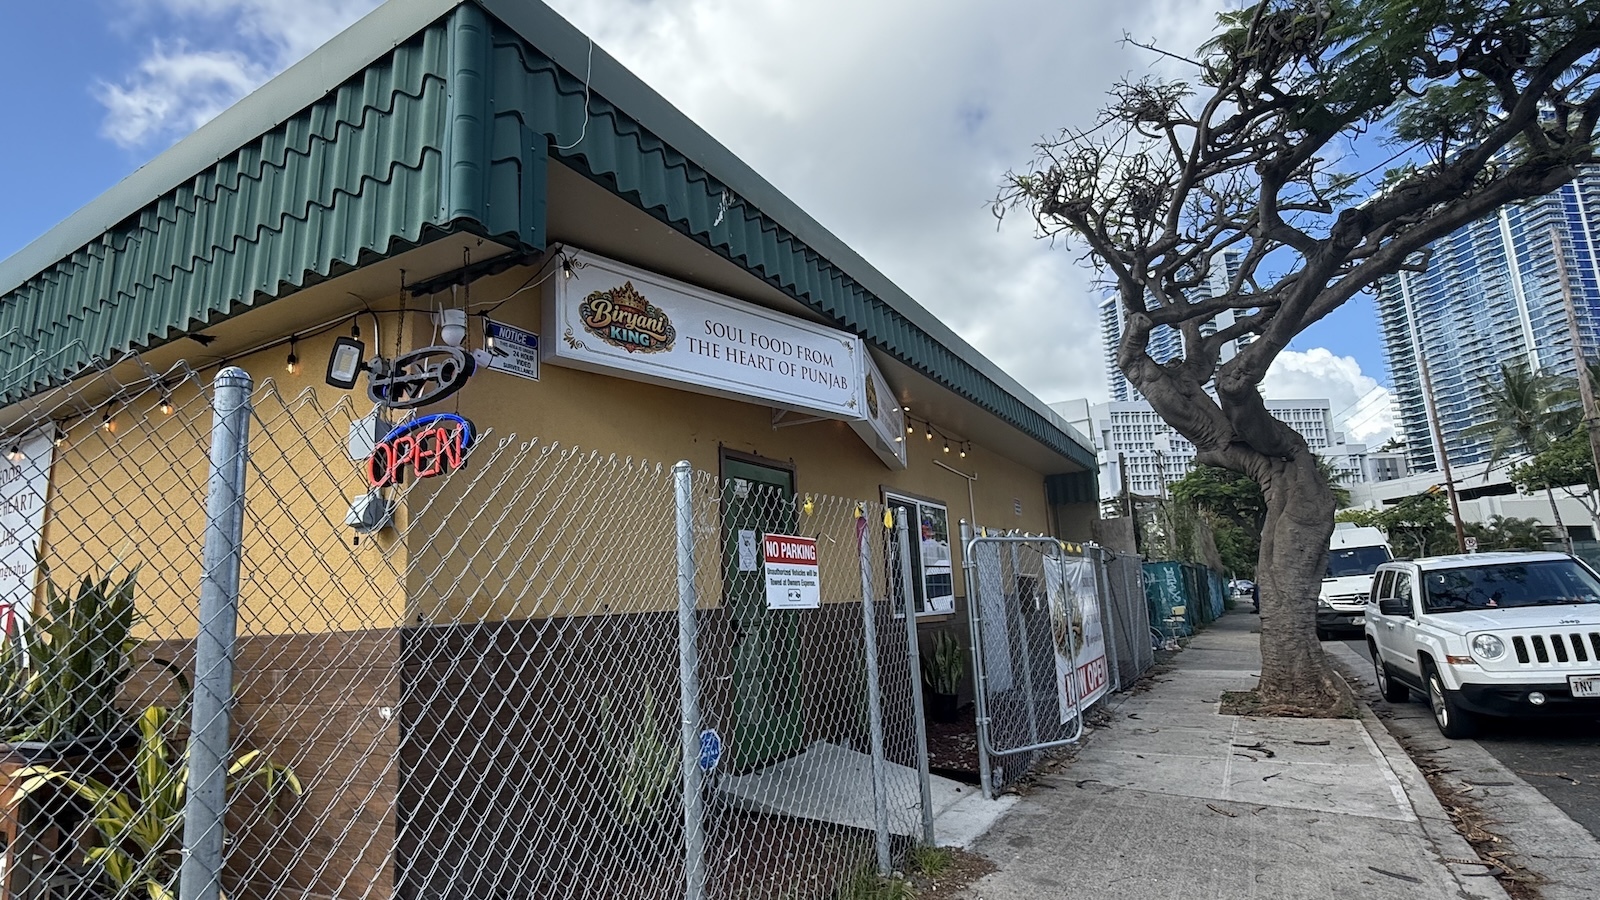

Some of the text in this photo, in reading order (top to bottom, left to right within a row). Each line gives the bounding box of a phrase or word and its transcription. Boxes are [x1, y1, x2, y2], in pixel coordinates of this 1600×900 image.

[587, 299, 667, 341] Biryani
[499, 328, 527, 344] NOTICE
[610, 325, 651, 346] KING
[704, 319, 834, 368] SOUL FOOD FROM
[513, 350, 534, 361] 24 HOUR
[516, 359, 531, 368] VIDEO
[686, 336, 848, 390] THE HEART OF PUNJAB
[367, 423, 464, 487] OPEN
[3, 491, 35, 517] HEART
[765, 540, 779, 557] NO
[781, 542, 816, 561] PARKING
[767, 567, 791, 576] Unauthorized
[792, 568, 806, 577] Vehicles
[770, 578, 782, 586] Towed
[787, 578, 801, 586] Owners
[1066, 667, 1088, 705] NW
